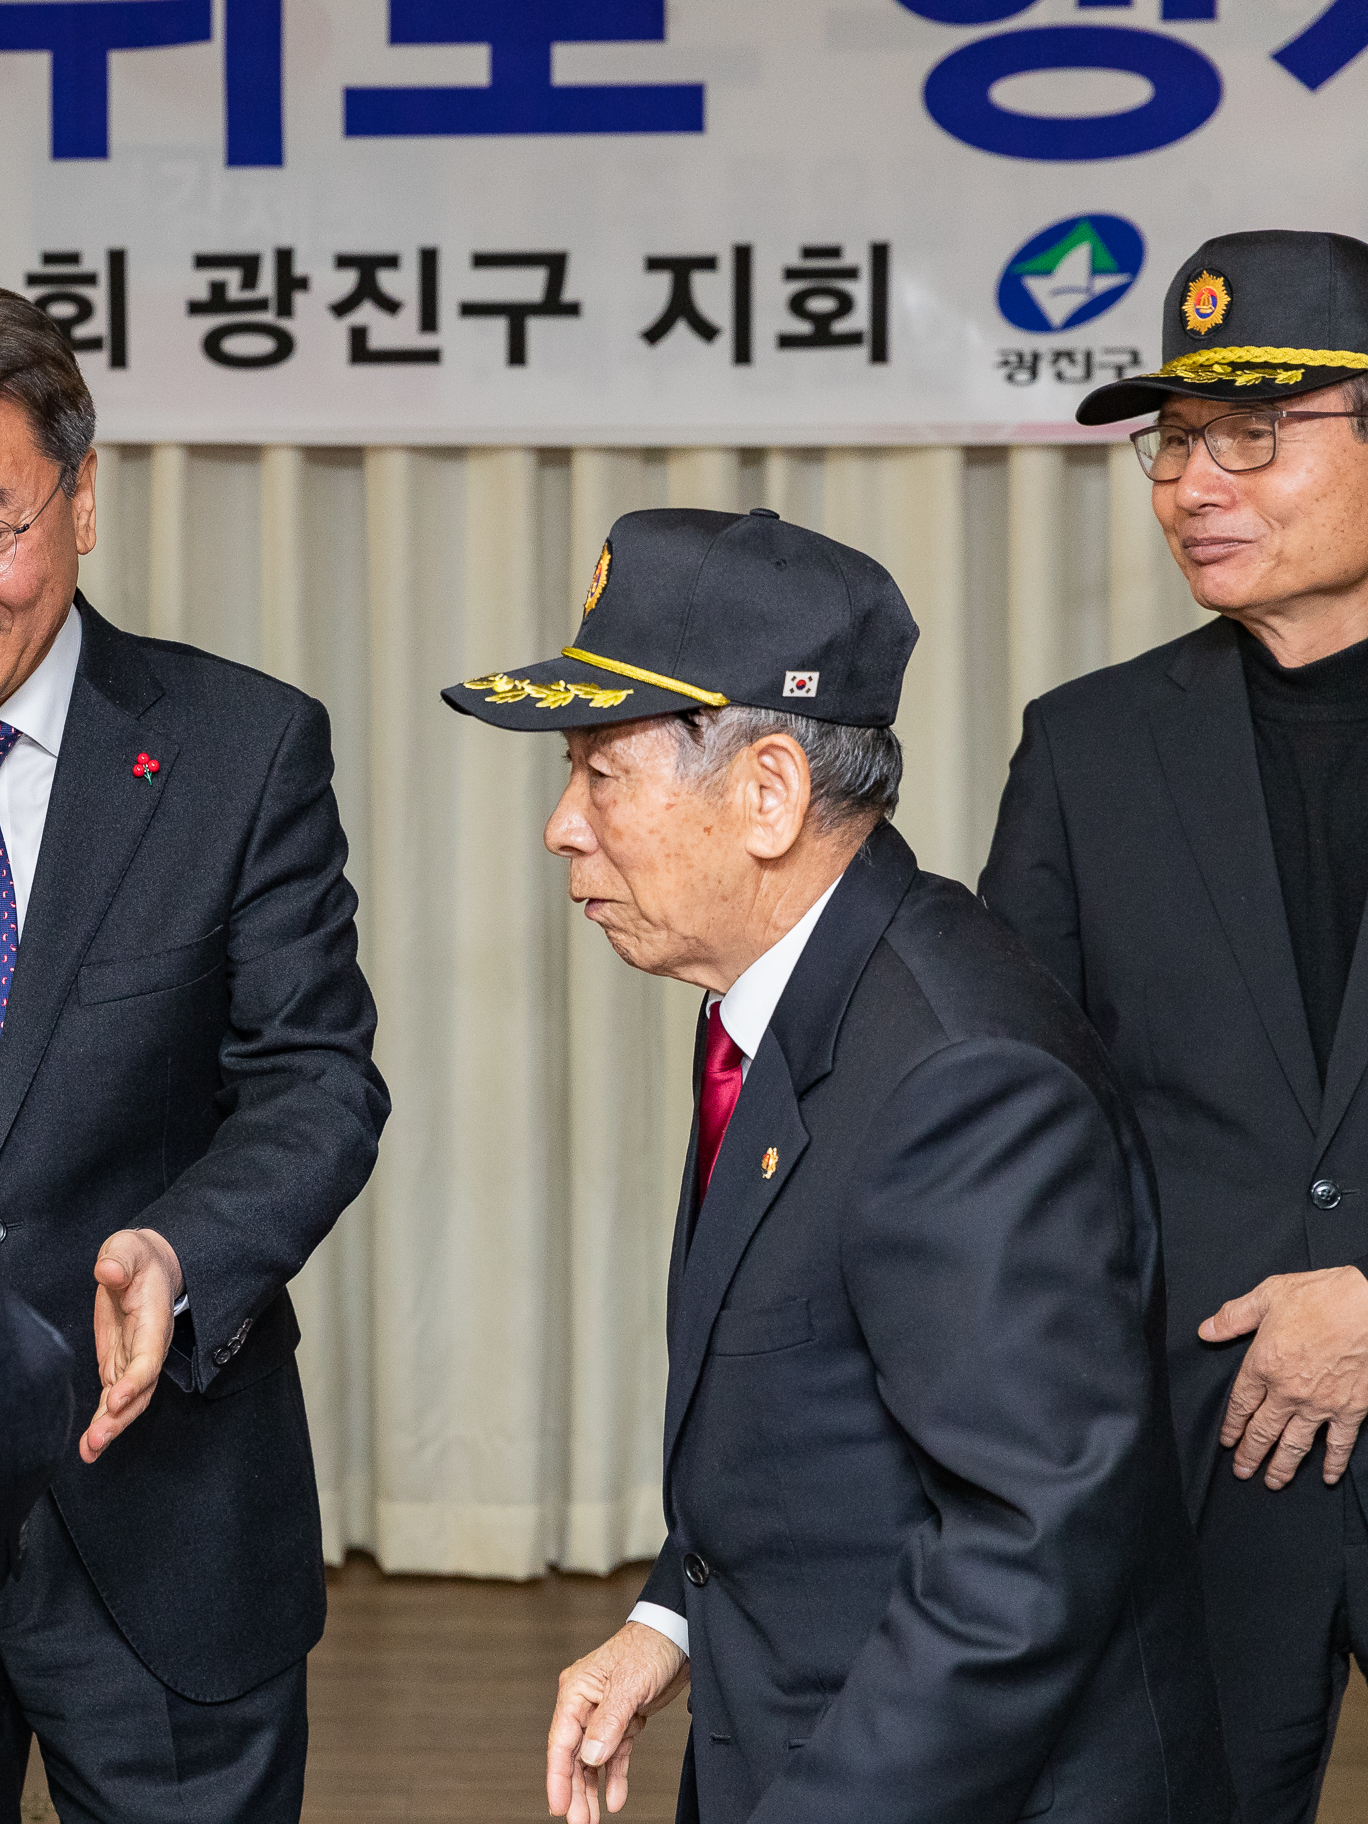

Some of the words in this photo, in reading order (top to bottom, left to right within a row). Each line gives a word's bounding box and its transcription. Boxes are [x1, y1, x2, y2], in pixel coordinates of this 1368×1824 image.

[188, 245, 581, 370] 광진구
[640, 241, 892, 366] 지회
[993, 344, 1143, 387] 광진구
